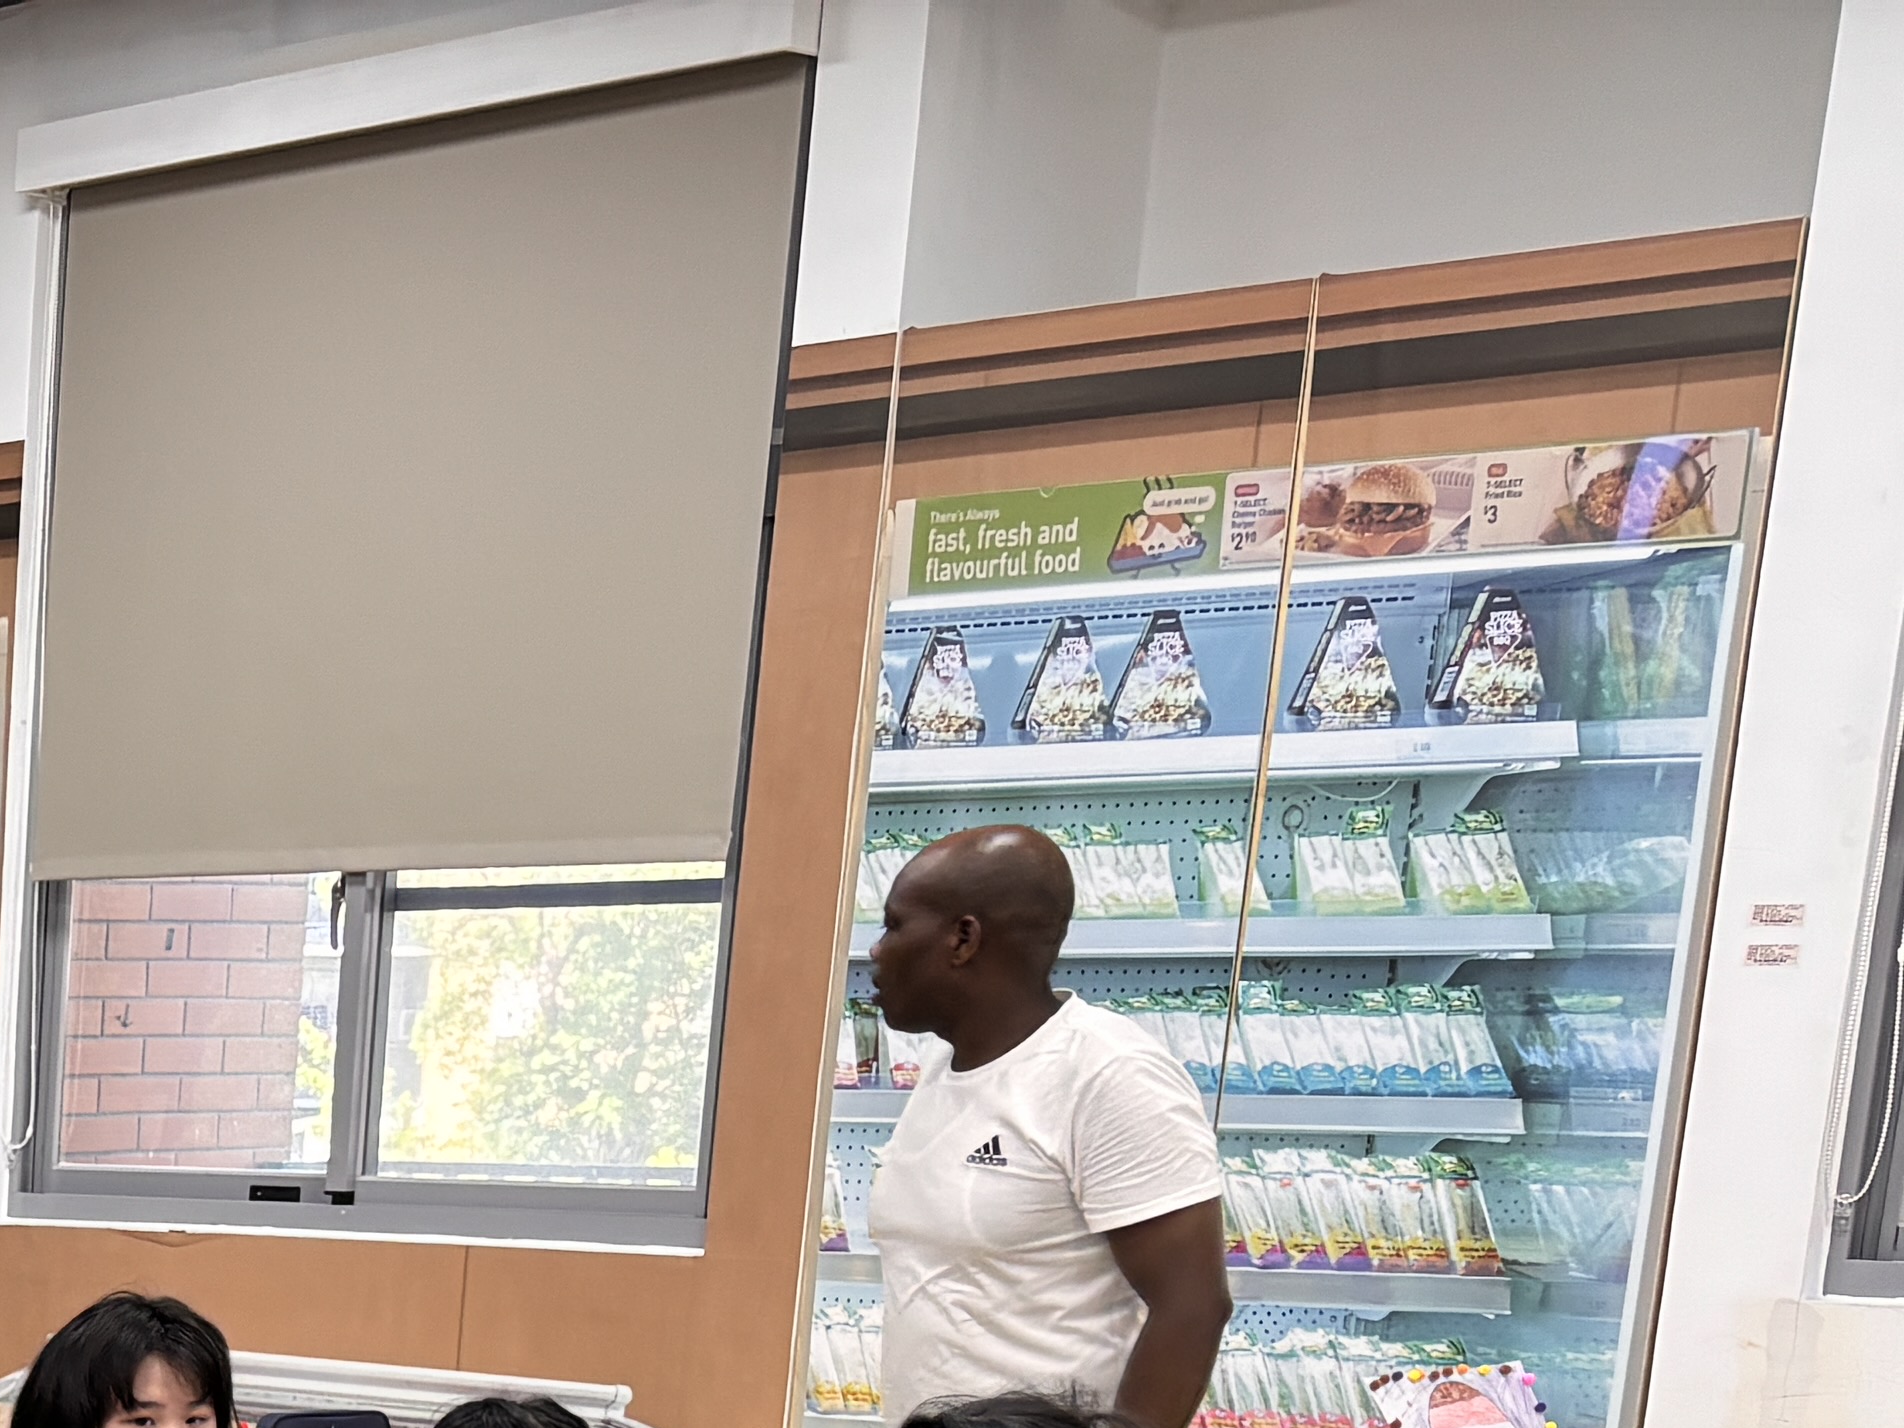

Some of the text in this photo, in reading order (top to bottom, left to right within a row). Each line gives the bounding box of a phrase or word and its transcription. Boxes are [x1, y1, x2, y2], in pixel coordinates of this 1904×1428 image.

[930, 507, 1000, 523] There's Always
[1484, 505, 1498, 524] $3
[928, 516, 1080, 554] fast, fresh and
[925, 546, 1082, 583] flavourful food
[1490, 611, 1519, 623] PIZZA
[1485, 620, 1522, 636] SLICE
[966, 1154, 1008, 1167] adidas
